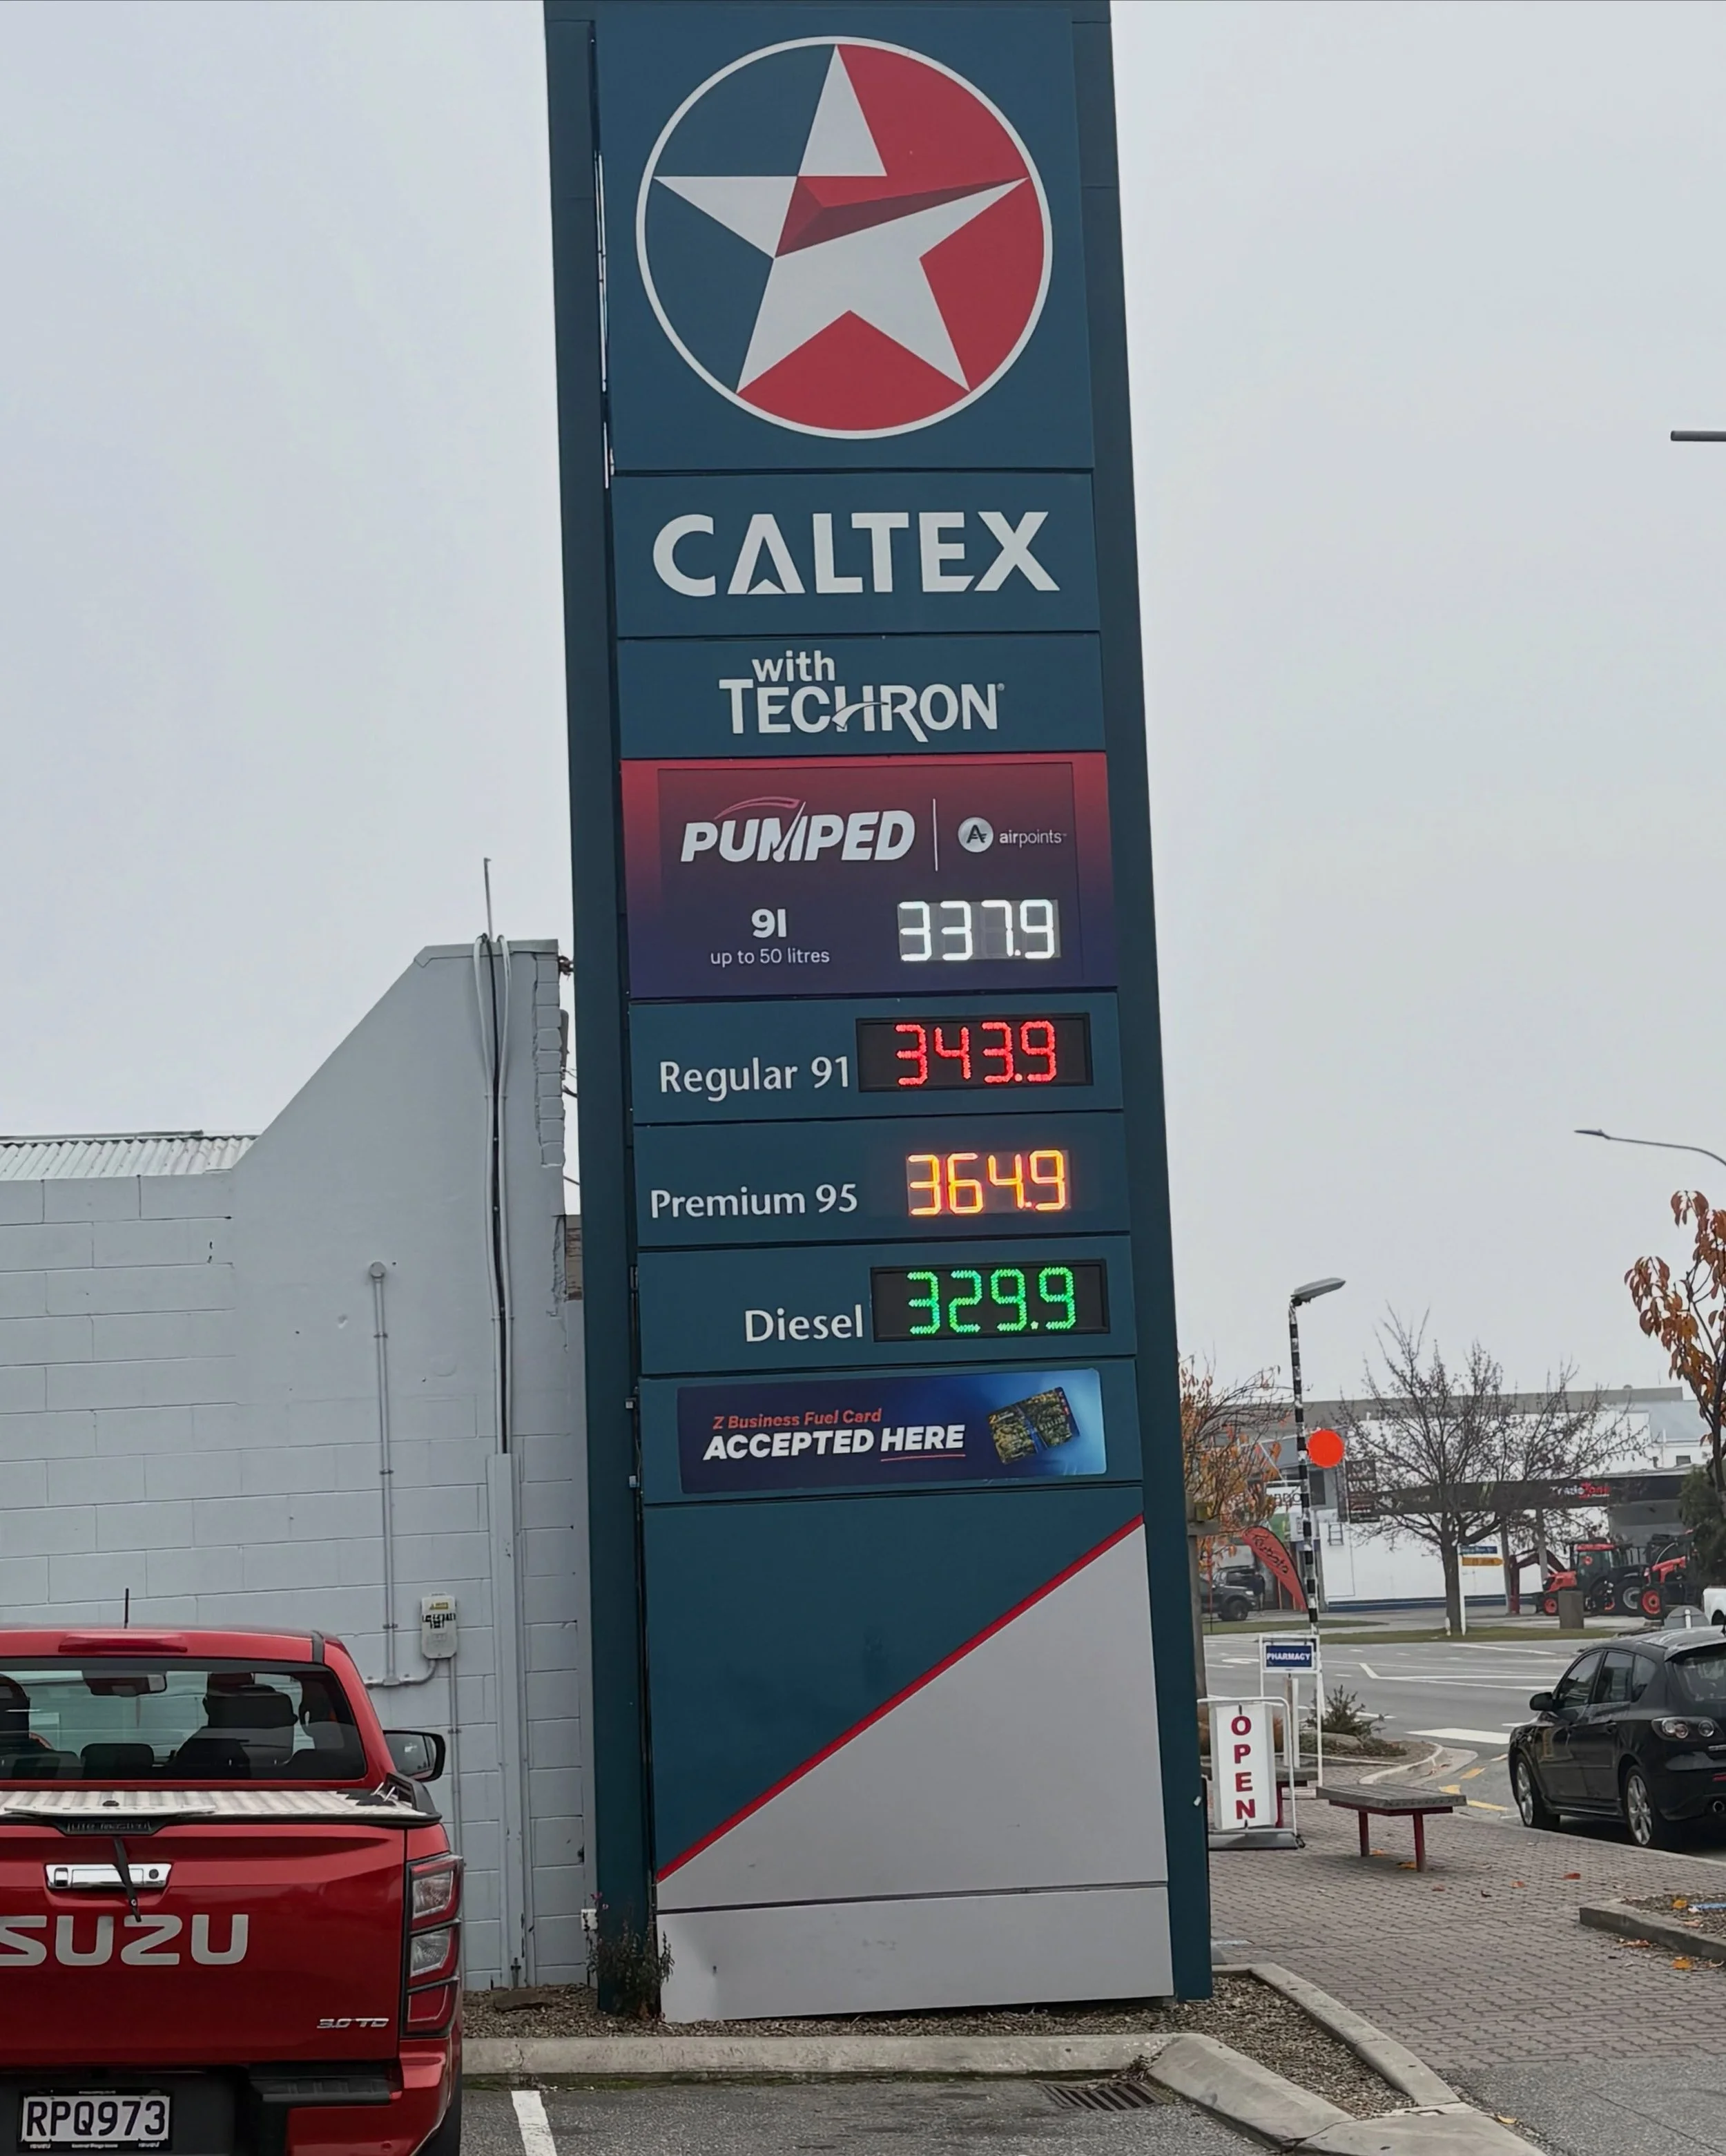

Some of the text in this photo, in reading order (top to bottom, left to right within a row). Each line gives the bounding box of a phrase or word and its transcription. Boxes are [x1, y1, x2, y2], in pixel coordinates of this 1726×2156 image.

[653, 512, 1060, 596] CALTEX
[752, 651, 835, 682] with
[680, 800, 915, 863] PUMPED
[752, 909, 786, 938] 91
[899, 900, 1055, 961] 337.9
[711, 948, 829, 968] up to 50 litres
[896, 1021, 1056, 1085] 343.9
[661, 1057, 848, 1101] Regular 91
[652, 1184, 857, 1217] Premium 95
[908, 1151, 1067, 1215] 364.9
[908, 1267, 1076, 1334] 329.9
[746, 1305, 862, 1341] Diesel
[712, 1408, 882, 1430] Z Business Fuel Card
[703, 1424, 965, 1460] ACCEPTED HERE
[1266, 1652, 1311, 1660] PHARMACY
[1231, 1715, 1256, 1820] OPEN
[355, 2018, 389, 2028] TD
[26, 2100, 166, 2136] RPQ973
